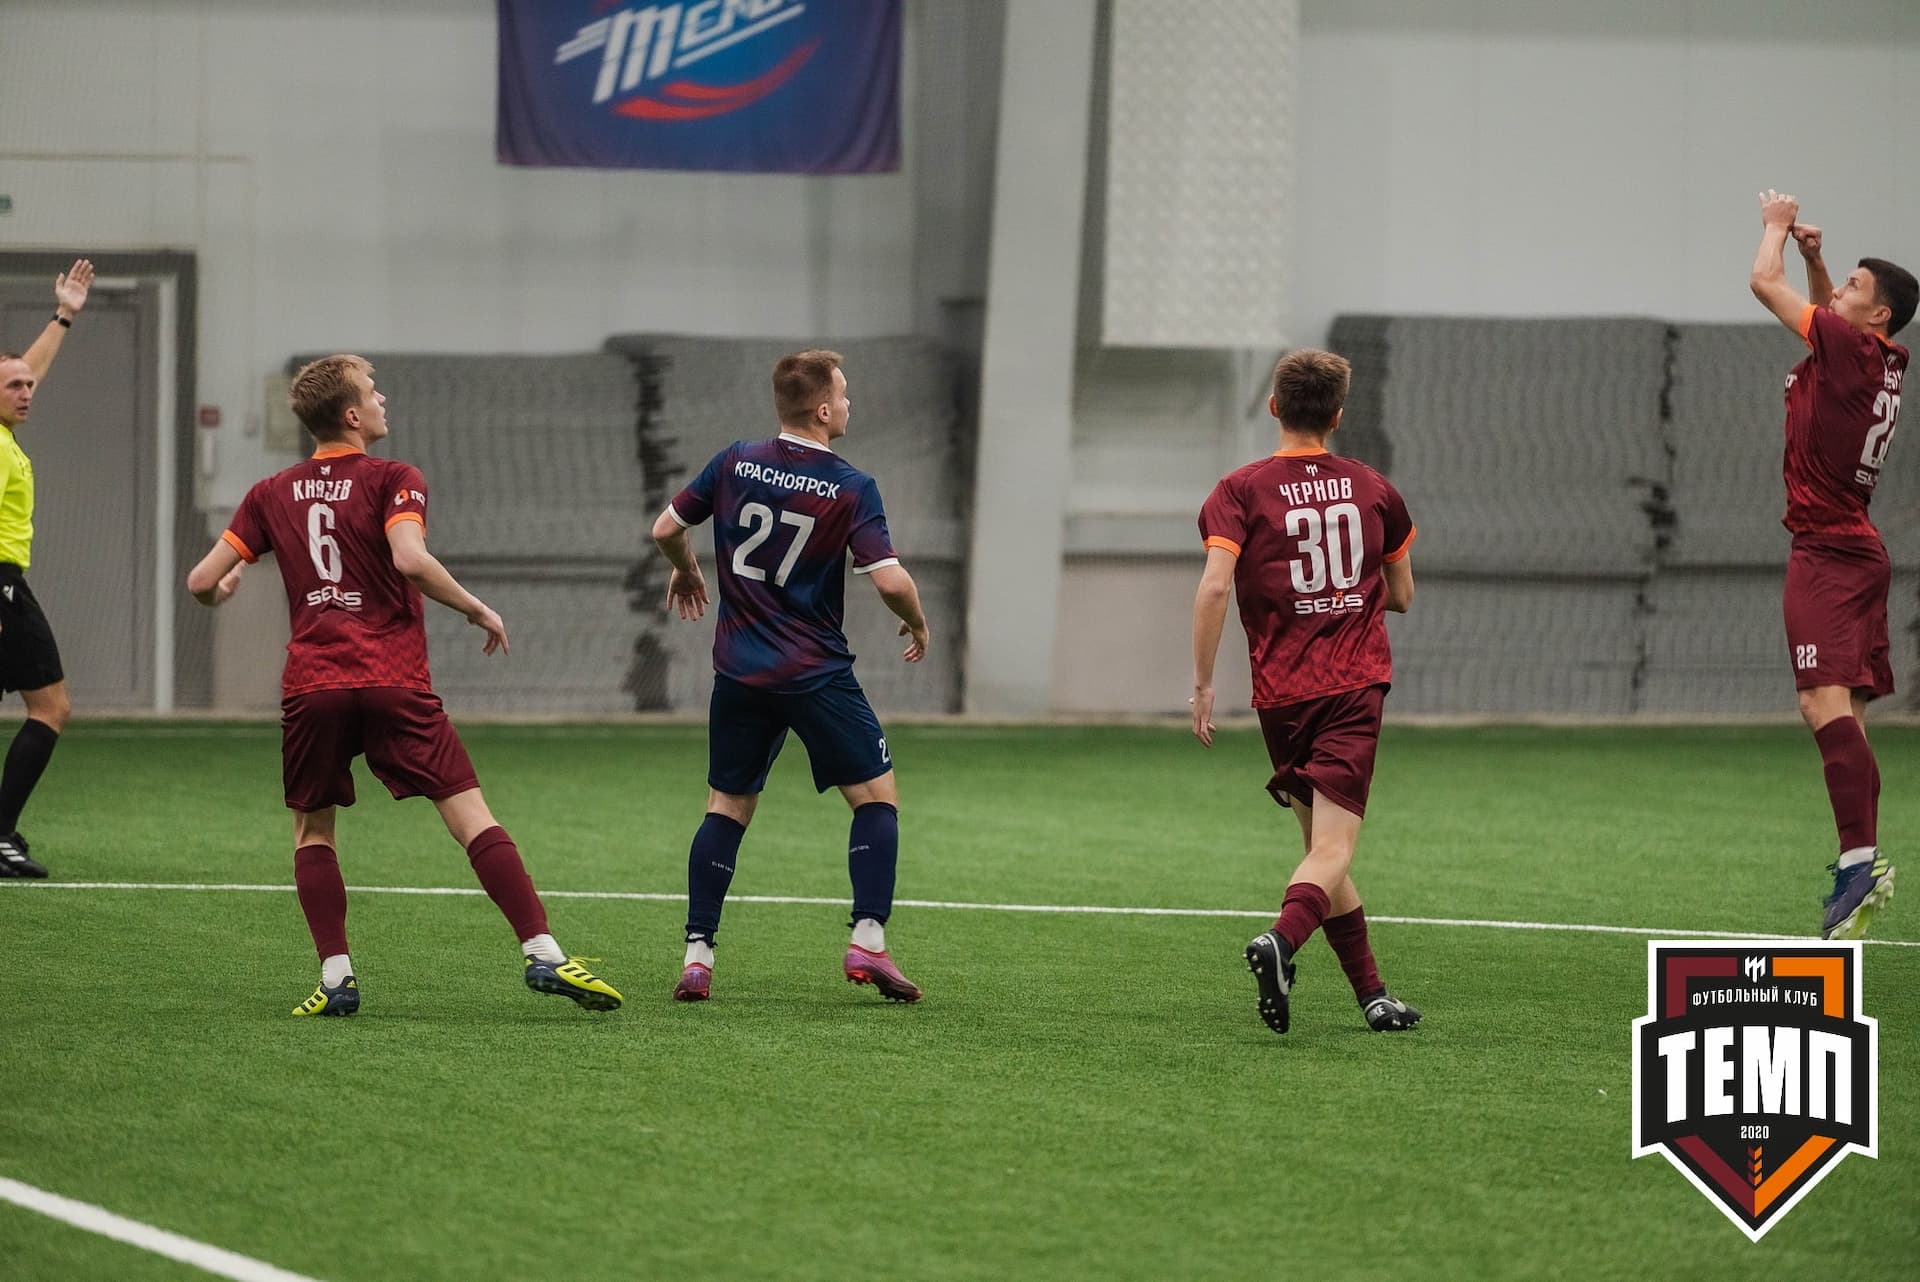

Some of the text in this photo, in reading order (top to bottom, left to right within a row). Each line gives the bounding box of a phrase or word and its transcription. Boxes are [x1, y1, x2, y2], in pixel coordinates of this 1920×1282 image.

[735, 461, 840, 499] КРАСНОЯРСК
[1279, 477, 1353, 506] ЧЕРНОВ
[308, 502, 343, 583] 6
[732, 502, 816, 588] 27
[1285, 502, 1364, 594] 30
[1796, 643, 1818, 669] 22
